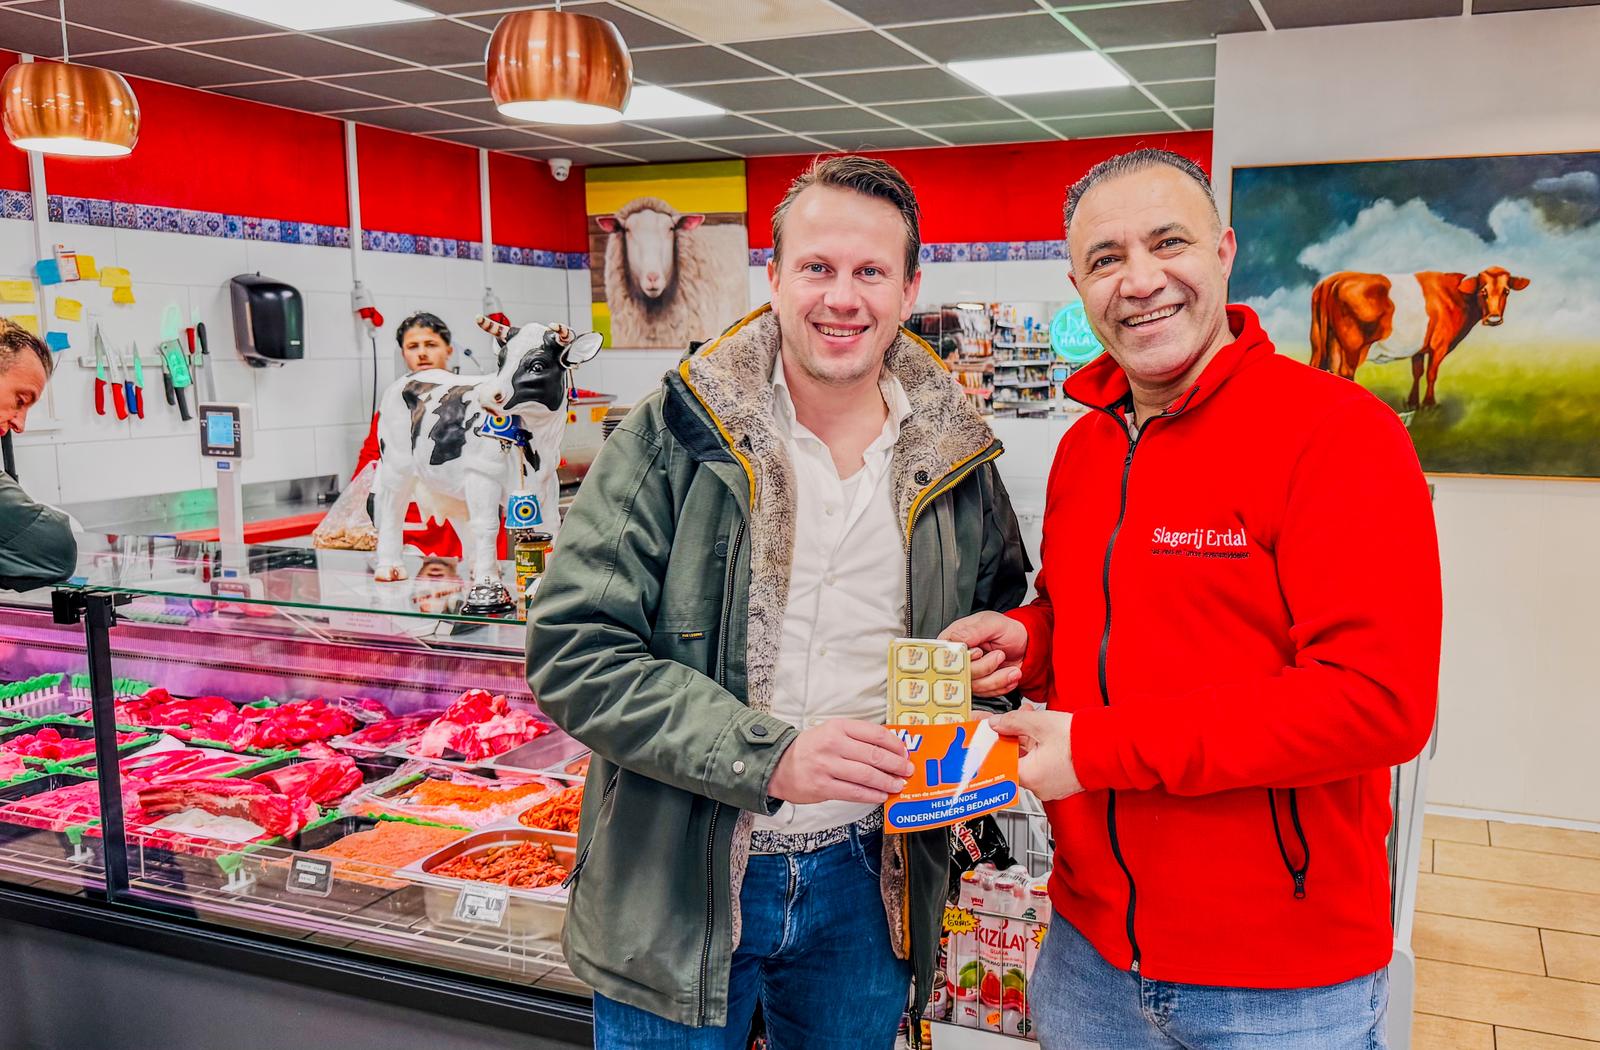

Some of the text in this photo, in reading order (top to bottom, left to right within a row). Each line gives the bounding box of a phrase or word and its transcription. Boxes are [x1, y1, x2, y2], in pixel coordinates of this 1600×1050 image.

[1151, 526, 1248, 550] Slagerij Erdal
[896, 792, 1010, 824] ONDERNEMERS BEDANKT!
[931, 792, 978, 809] HELMONDSE
[974, 926, 1029, 952] KIZILAY
